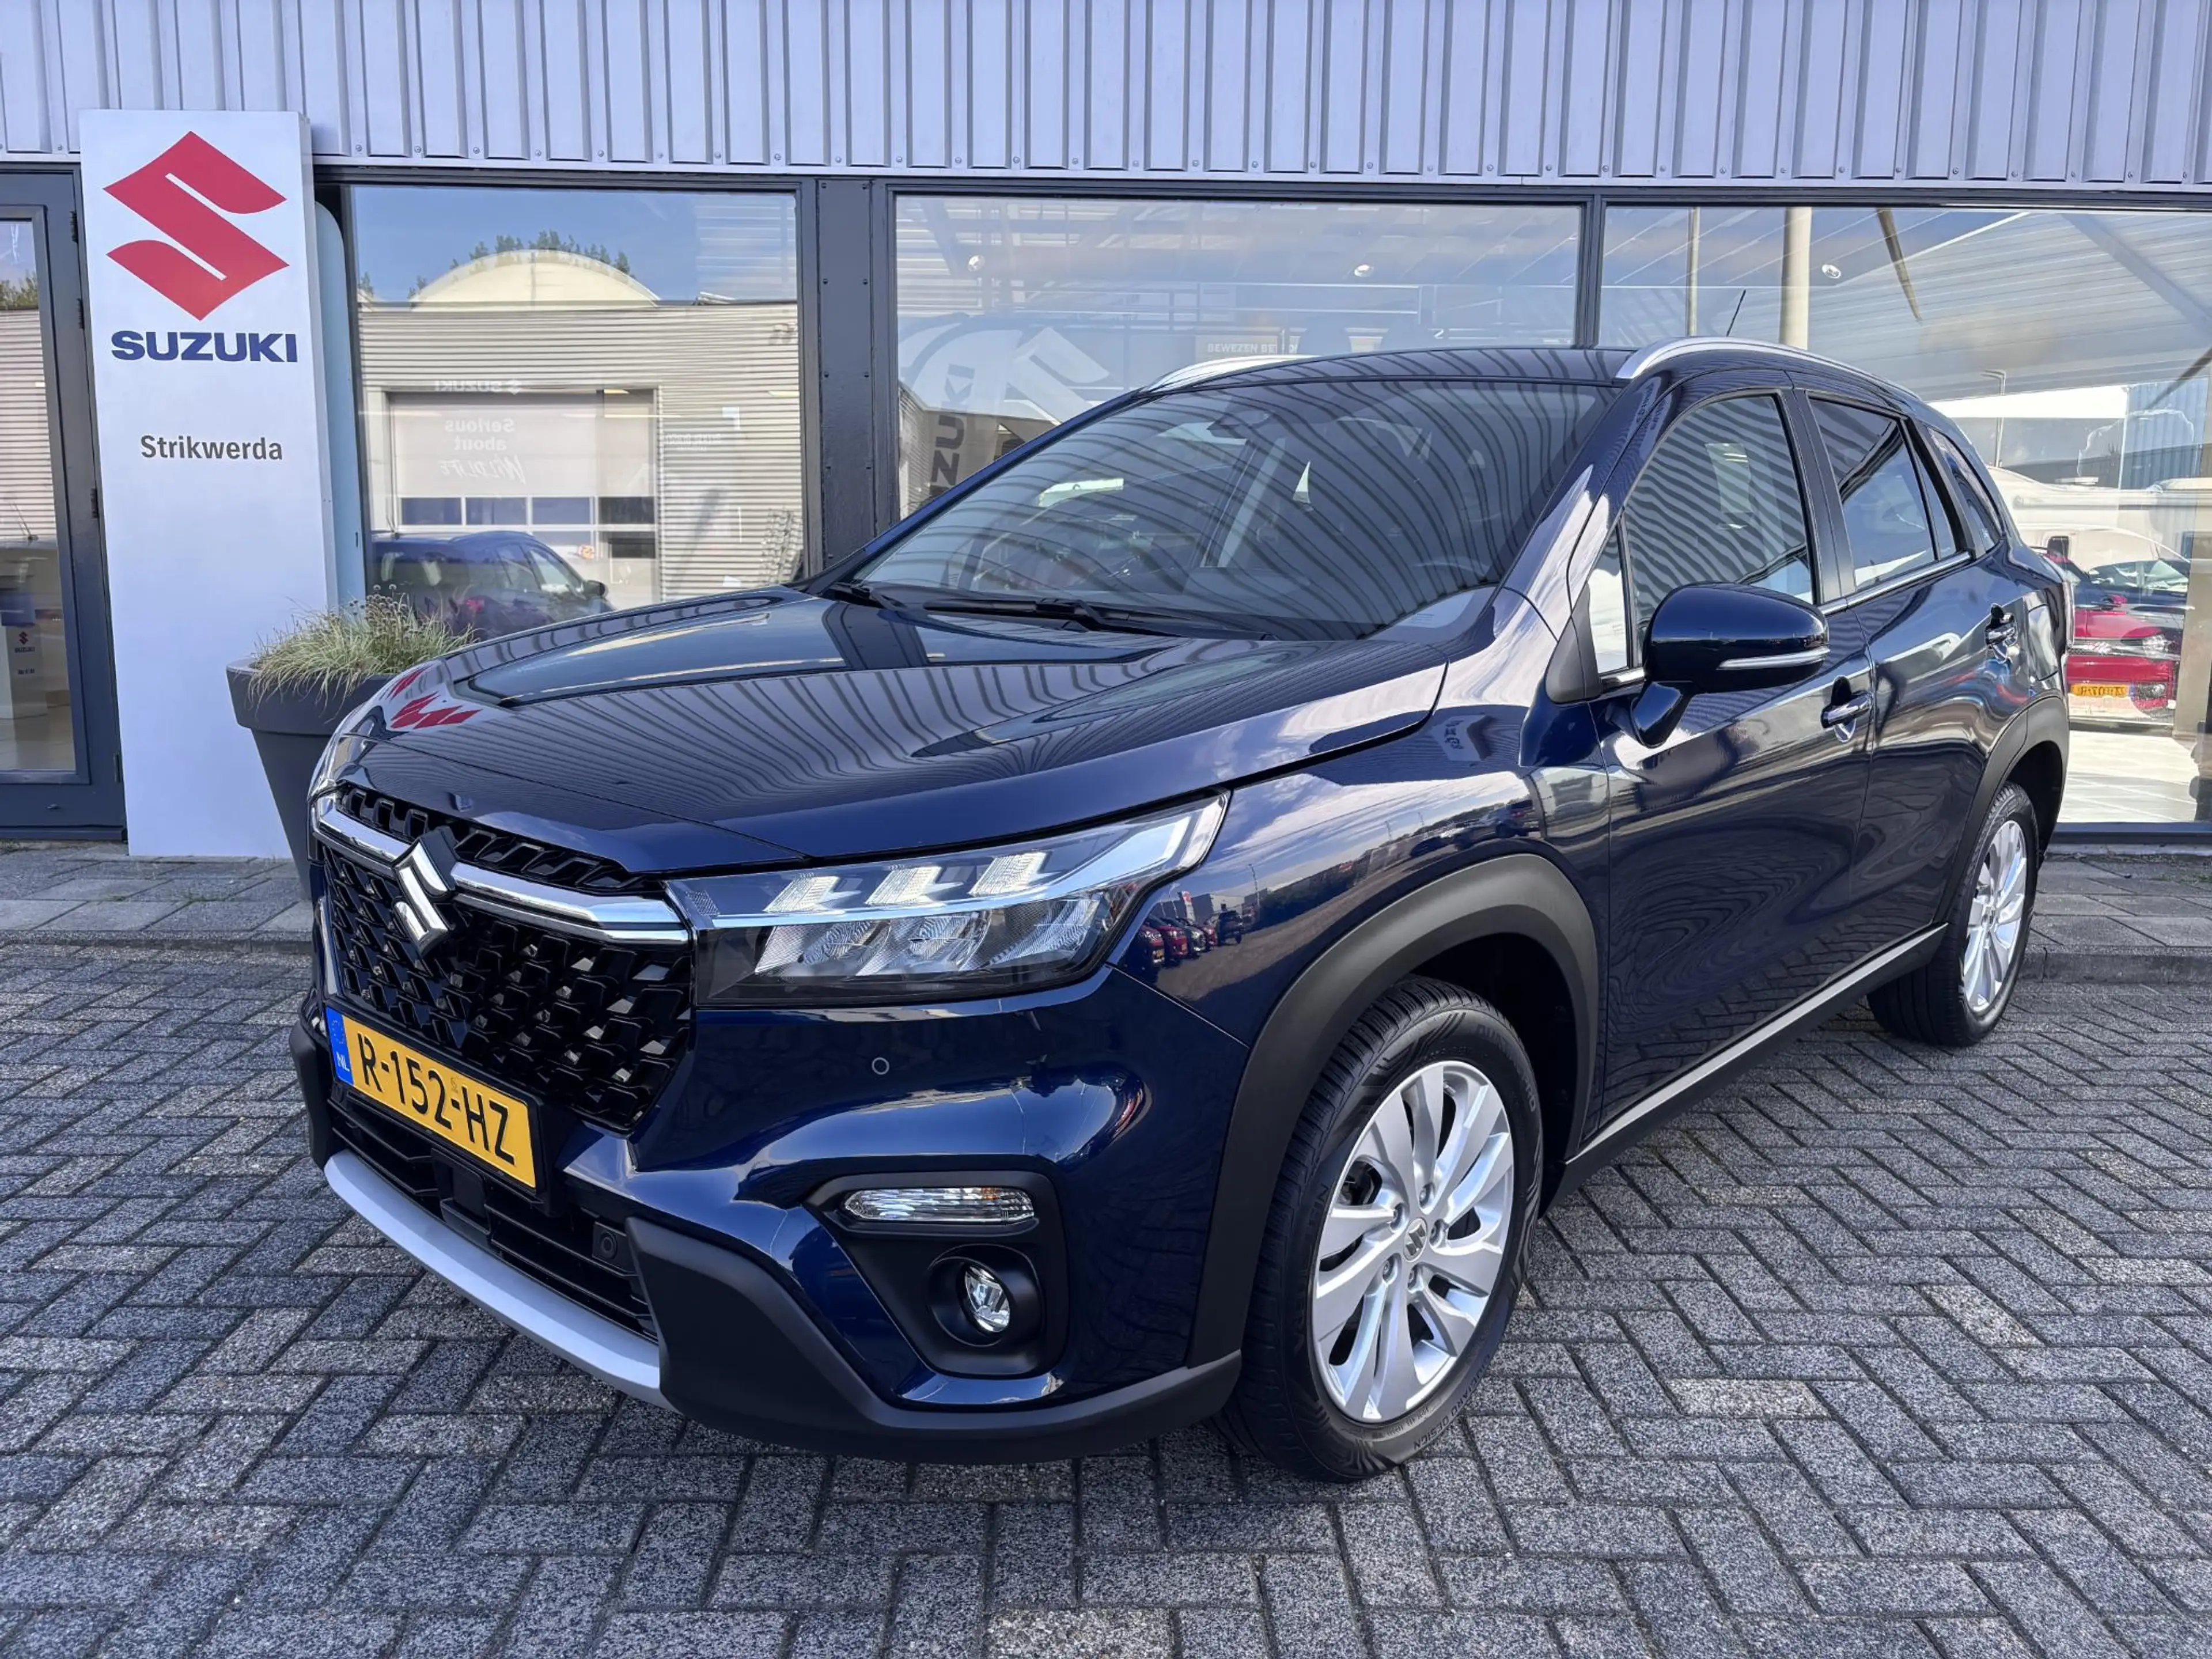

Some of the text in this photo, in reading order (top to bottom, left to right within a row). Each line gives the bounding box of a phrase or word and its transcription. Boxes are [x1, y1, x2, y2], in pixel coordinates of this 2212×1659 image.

[111, 329, 298, 362] SUZUKI
[1207, 343, 1258, 353] BEWEZEN
[929, 363, 976, 498] ZUKI
[140, 435, 283, 460] Strikwerda
[357, 1032, 516, 1165] R-152-HZ
